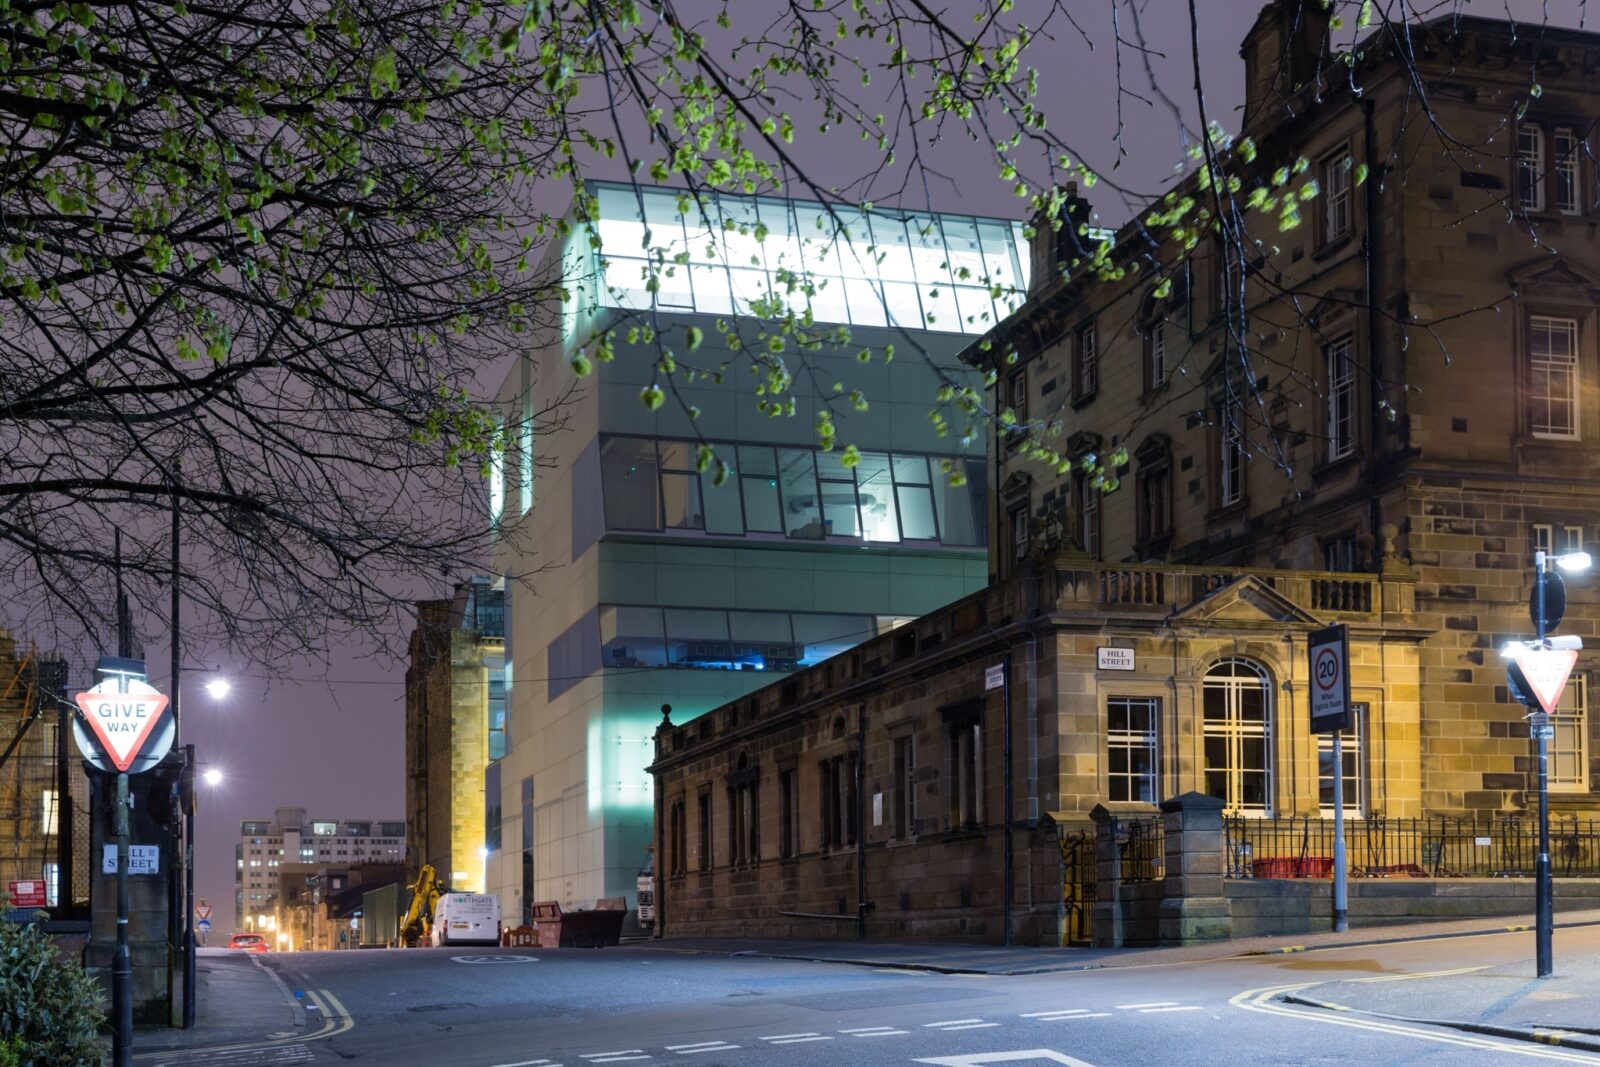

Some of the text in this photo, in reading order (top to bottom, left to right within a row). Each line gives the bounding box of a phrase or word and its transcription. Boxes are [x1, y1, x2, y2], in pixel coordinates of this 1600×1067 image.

[1319, 660, 1335, 678] 20
[98, 702, 147, 718] GIVE
[1314, 702, 1329, 711] lights
[107, 722, 138, 732] WAY
[107, 858, 154, 868] SEET
